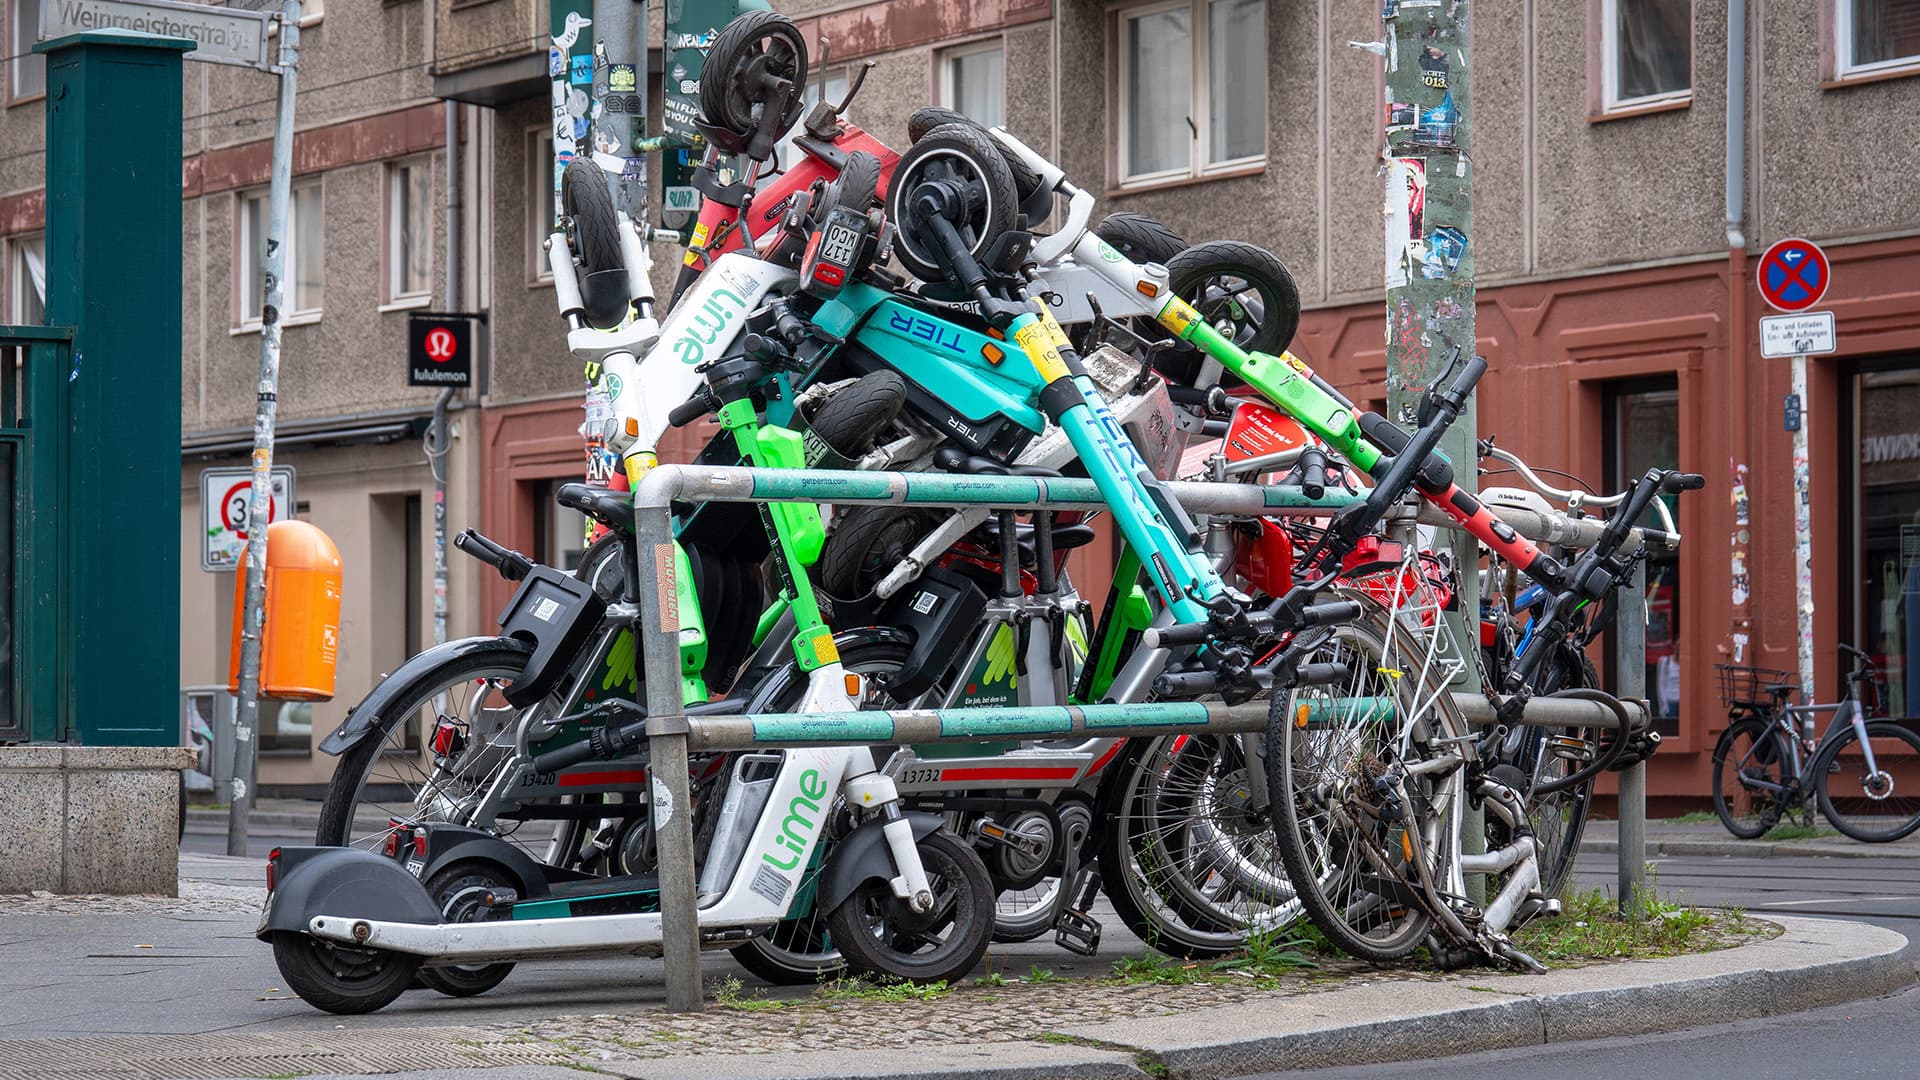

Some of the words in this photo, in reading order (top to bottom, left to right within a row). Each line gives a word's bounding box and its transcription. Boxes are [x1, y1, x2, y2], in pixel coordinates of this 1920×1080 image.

[831, 227, 857, 247] WCO
[824, 243, 850, 262] 117
[890, 310, 965, 354] TIER
[414, 368, 467, 382] lululemon
[947, 415, 979, 443] TIER
[232, 497, 247, 523] 3
[664, 555, 674, 585] MUY
[667, 589, 677, 619] BIEN
[521, 773, 556, 787] 13420
[901, 769, 940, 784] 13732
